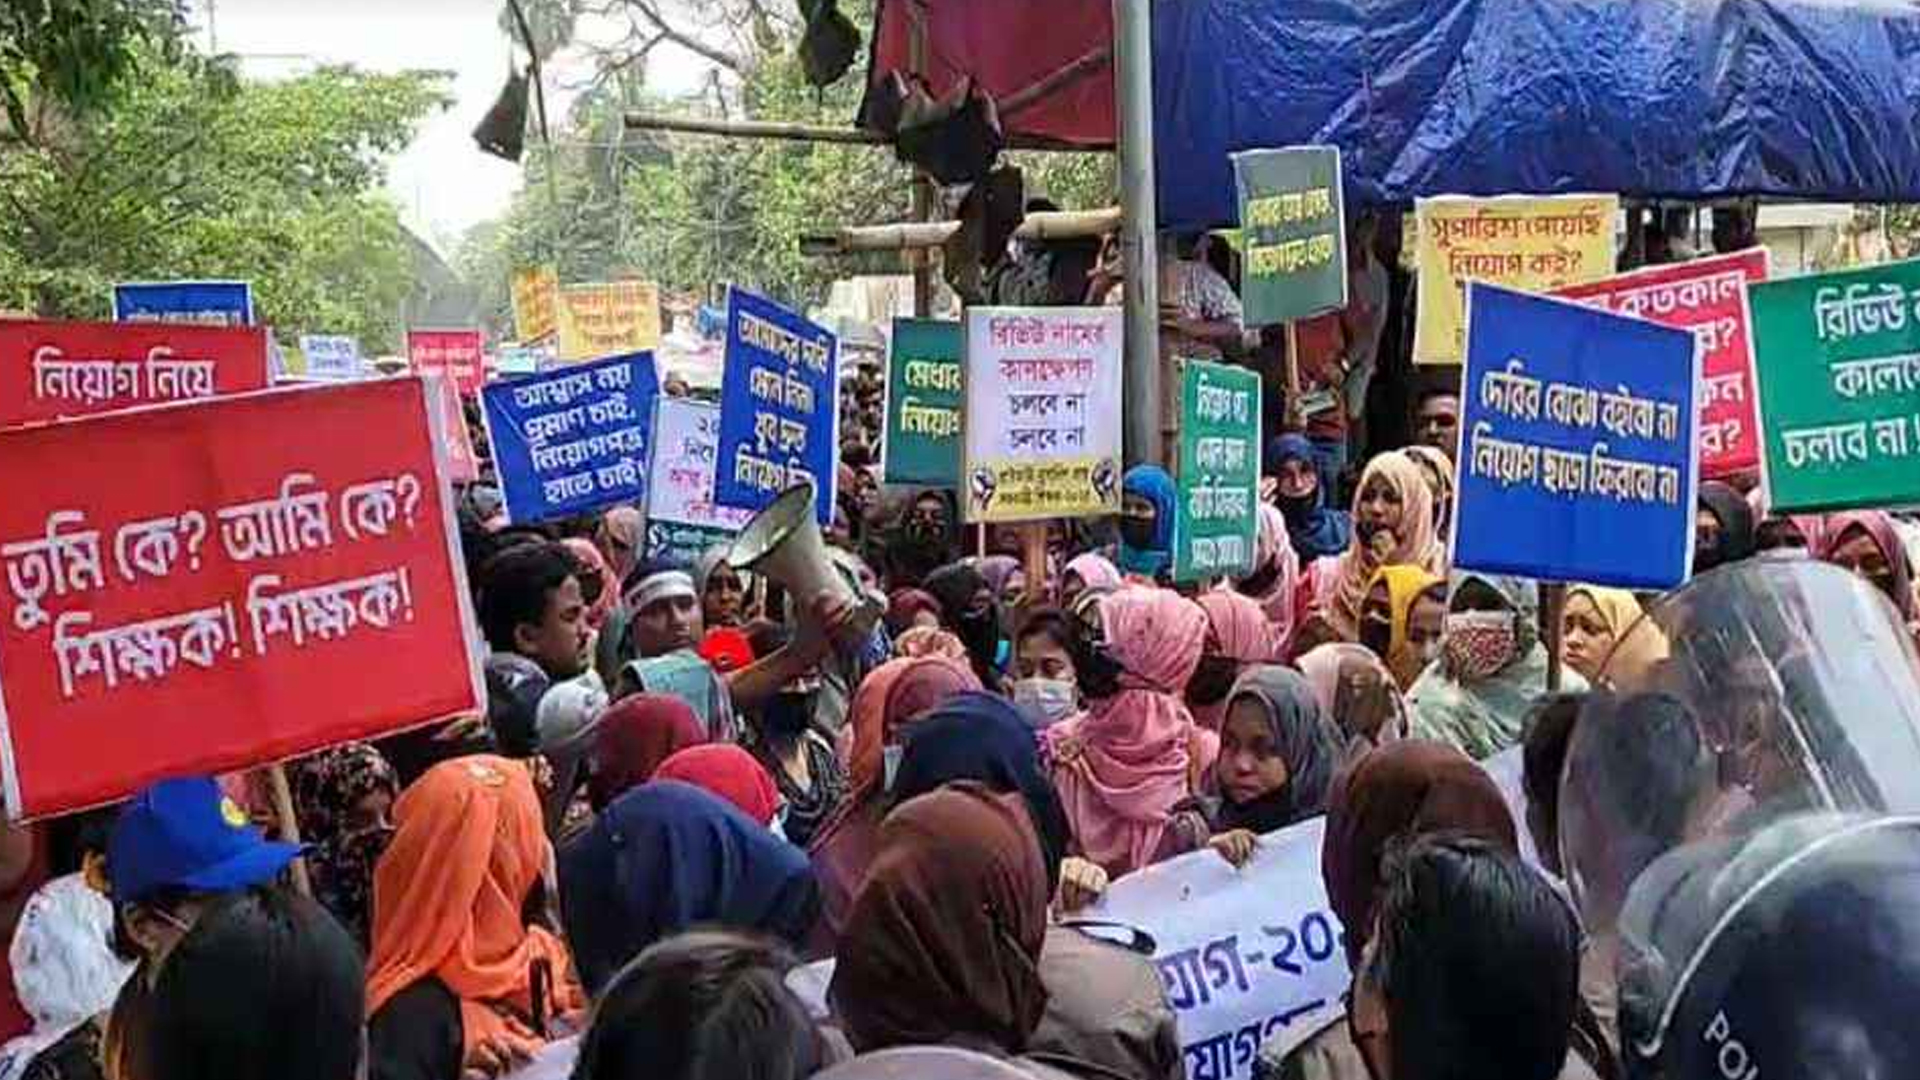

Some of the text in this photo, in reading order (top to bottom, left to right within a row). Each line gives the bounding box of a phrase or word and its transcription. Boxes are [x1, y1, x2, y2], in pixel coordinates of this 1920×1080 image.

[1448, 246, 1521, 277] নিয়োগ
[32, 345, 139, 404] নিয়োগ
[513, 362, 632, 409] আশ্বাস নয়
[1007, 394, 1087, 416] চলবে না
[1481, 359, 1542, 422] দেরির
[1658, 404, 1679, 441] না
[524, 405, 586, 443] প্রমাণ
[1010, 427, 1086, 450] চলবে না
[1782, 422, 1867, 467] চলবে
[529, 426, 644, 473] নিয়োগপত্র
[1470, 421, 1540, 487] নিয়োগ
[1658, 466, 1679, 504] না
[543, 471, 594, 502] হাতে
[1, 473, 422, 631] তুমি কে? আমি কে?
[53, 566, 414, 697] শিক্ষক! শিক্ষক!
